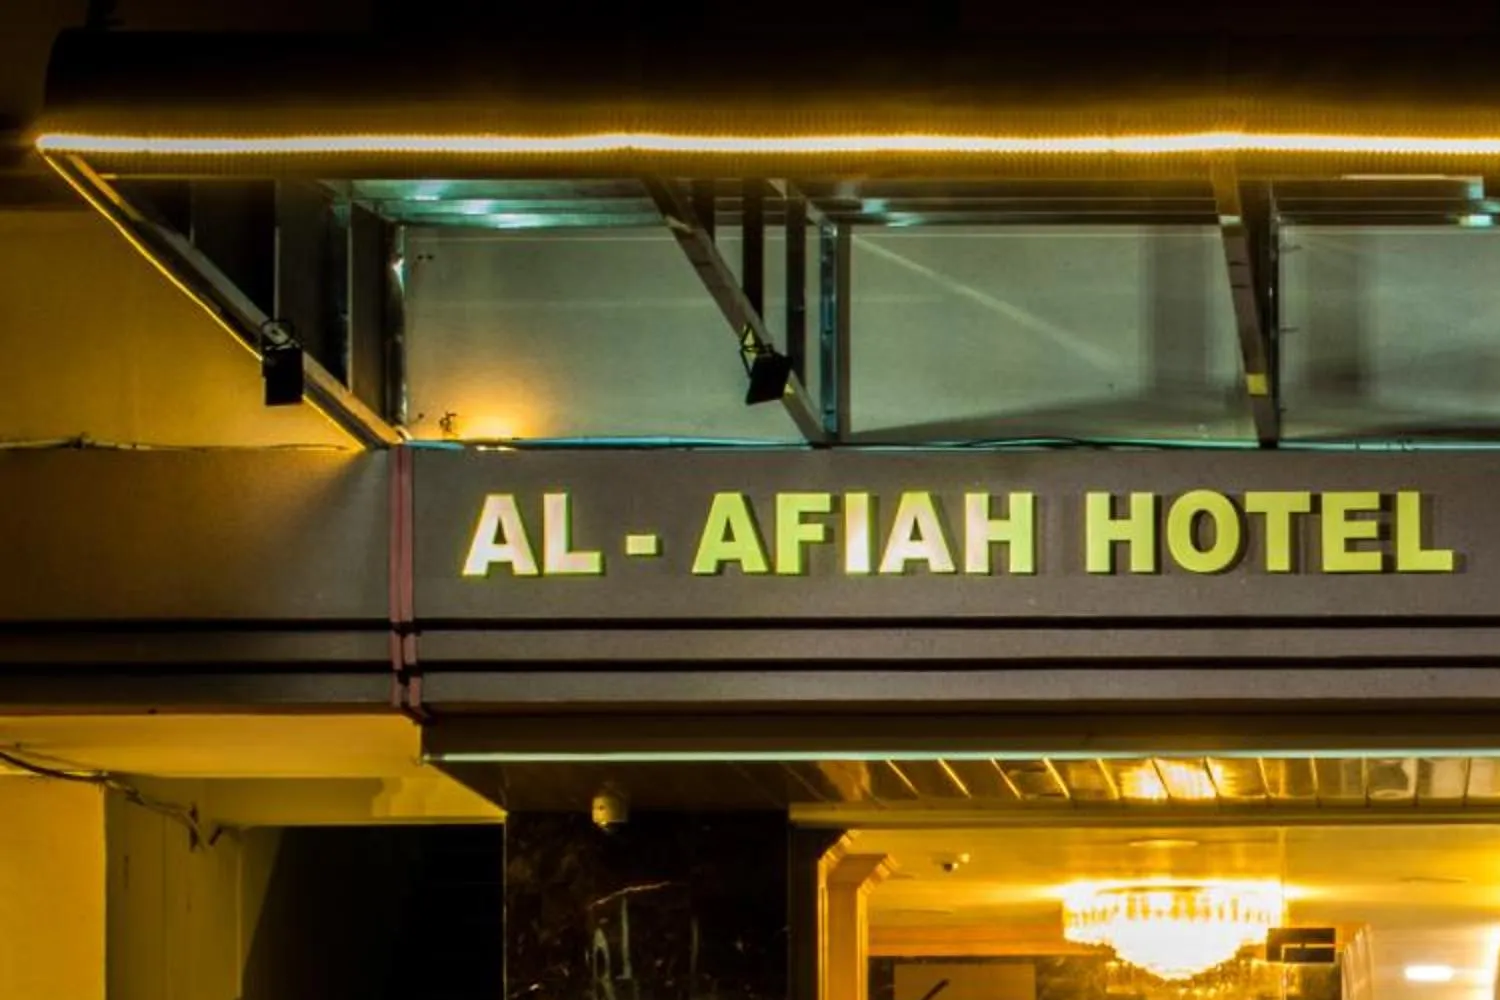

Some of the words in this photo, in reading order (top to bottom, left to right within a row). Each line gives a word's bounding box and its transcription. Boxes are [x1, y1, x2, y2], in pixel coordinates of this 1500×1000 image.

[461, 492, 602, 577] AL
[691, 491, 1036, 576] AFIAH
[1084, 489, 1455, 575] HOTEL
